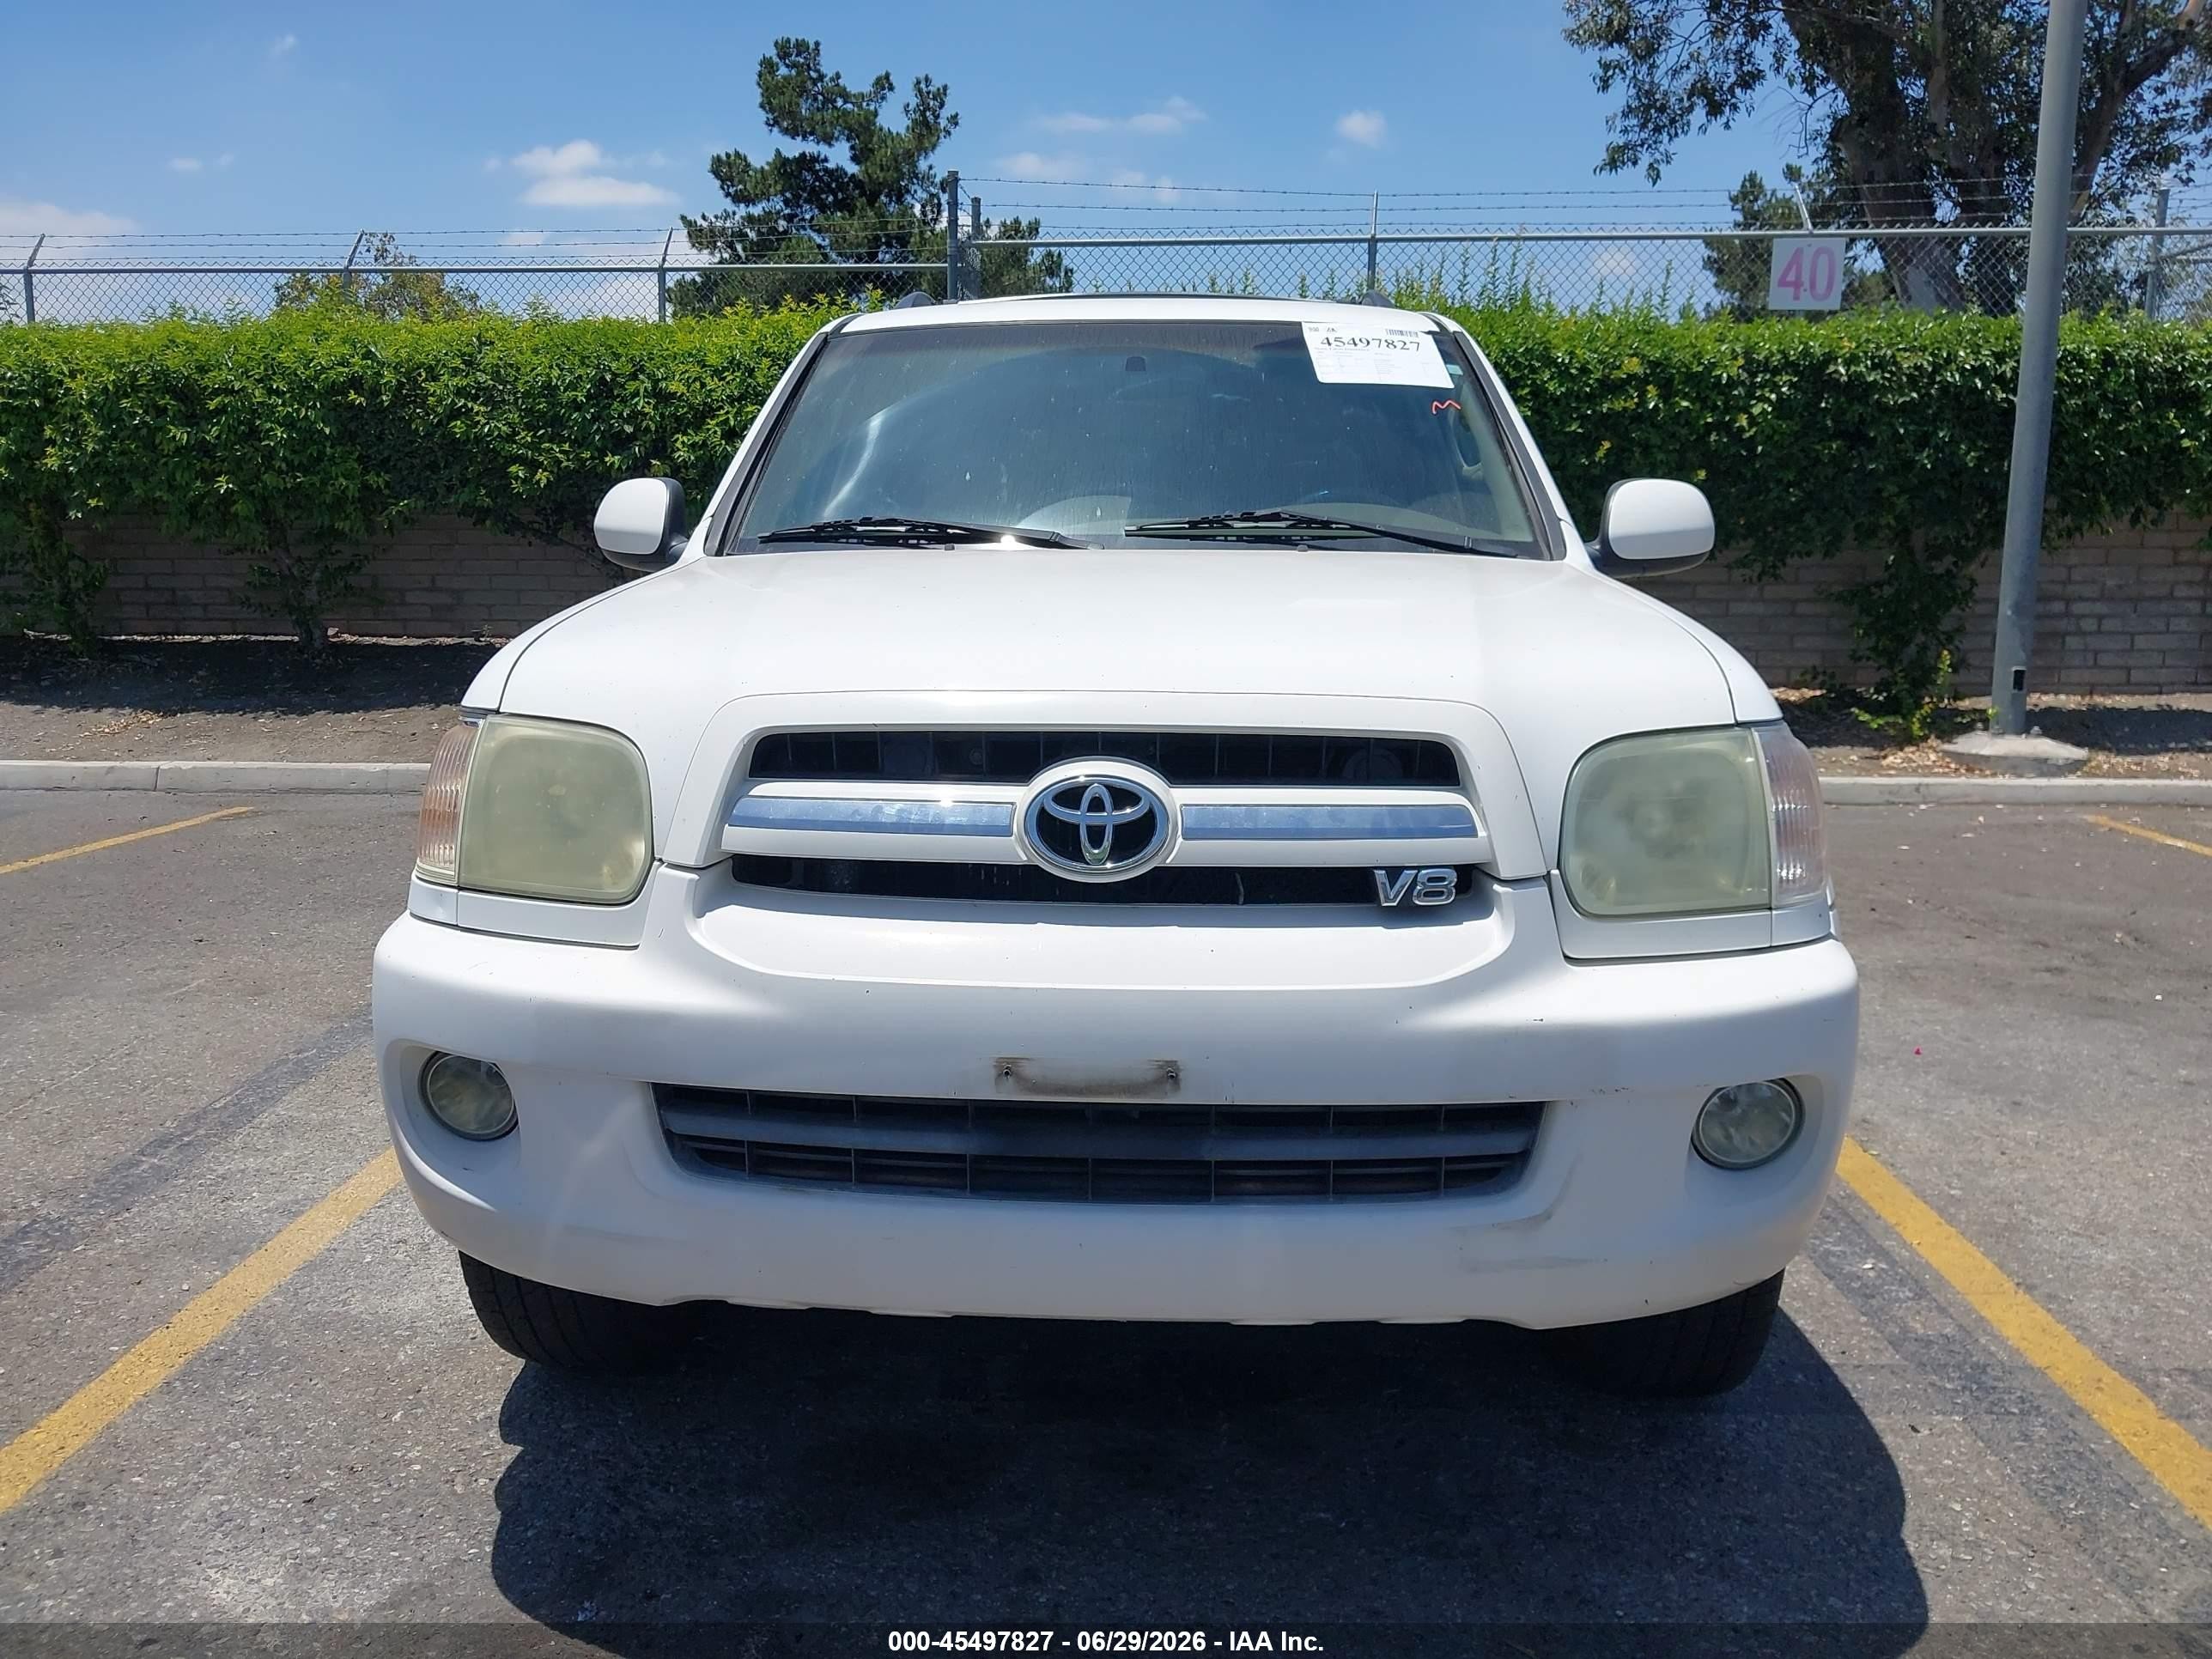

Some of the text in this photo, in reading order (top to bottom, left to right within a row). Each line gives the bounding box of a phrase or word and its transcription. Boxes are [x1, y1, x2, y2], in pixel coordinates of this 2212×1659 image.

[1777, 246, 1837, 302] 40
[1320, 336, 1420, 352] 45497827
[1373, 867, 1458, 907] V8
